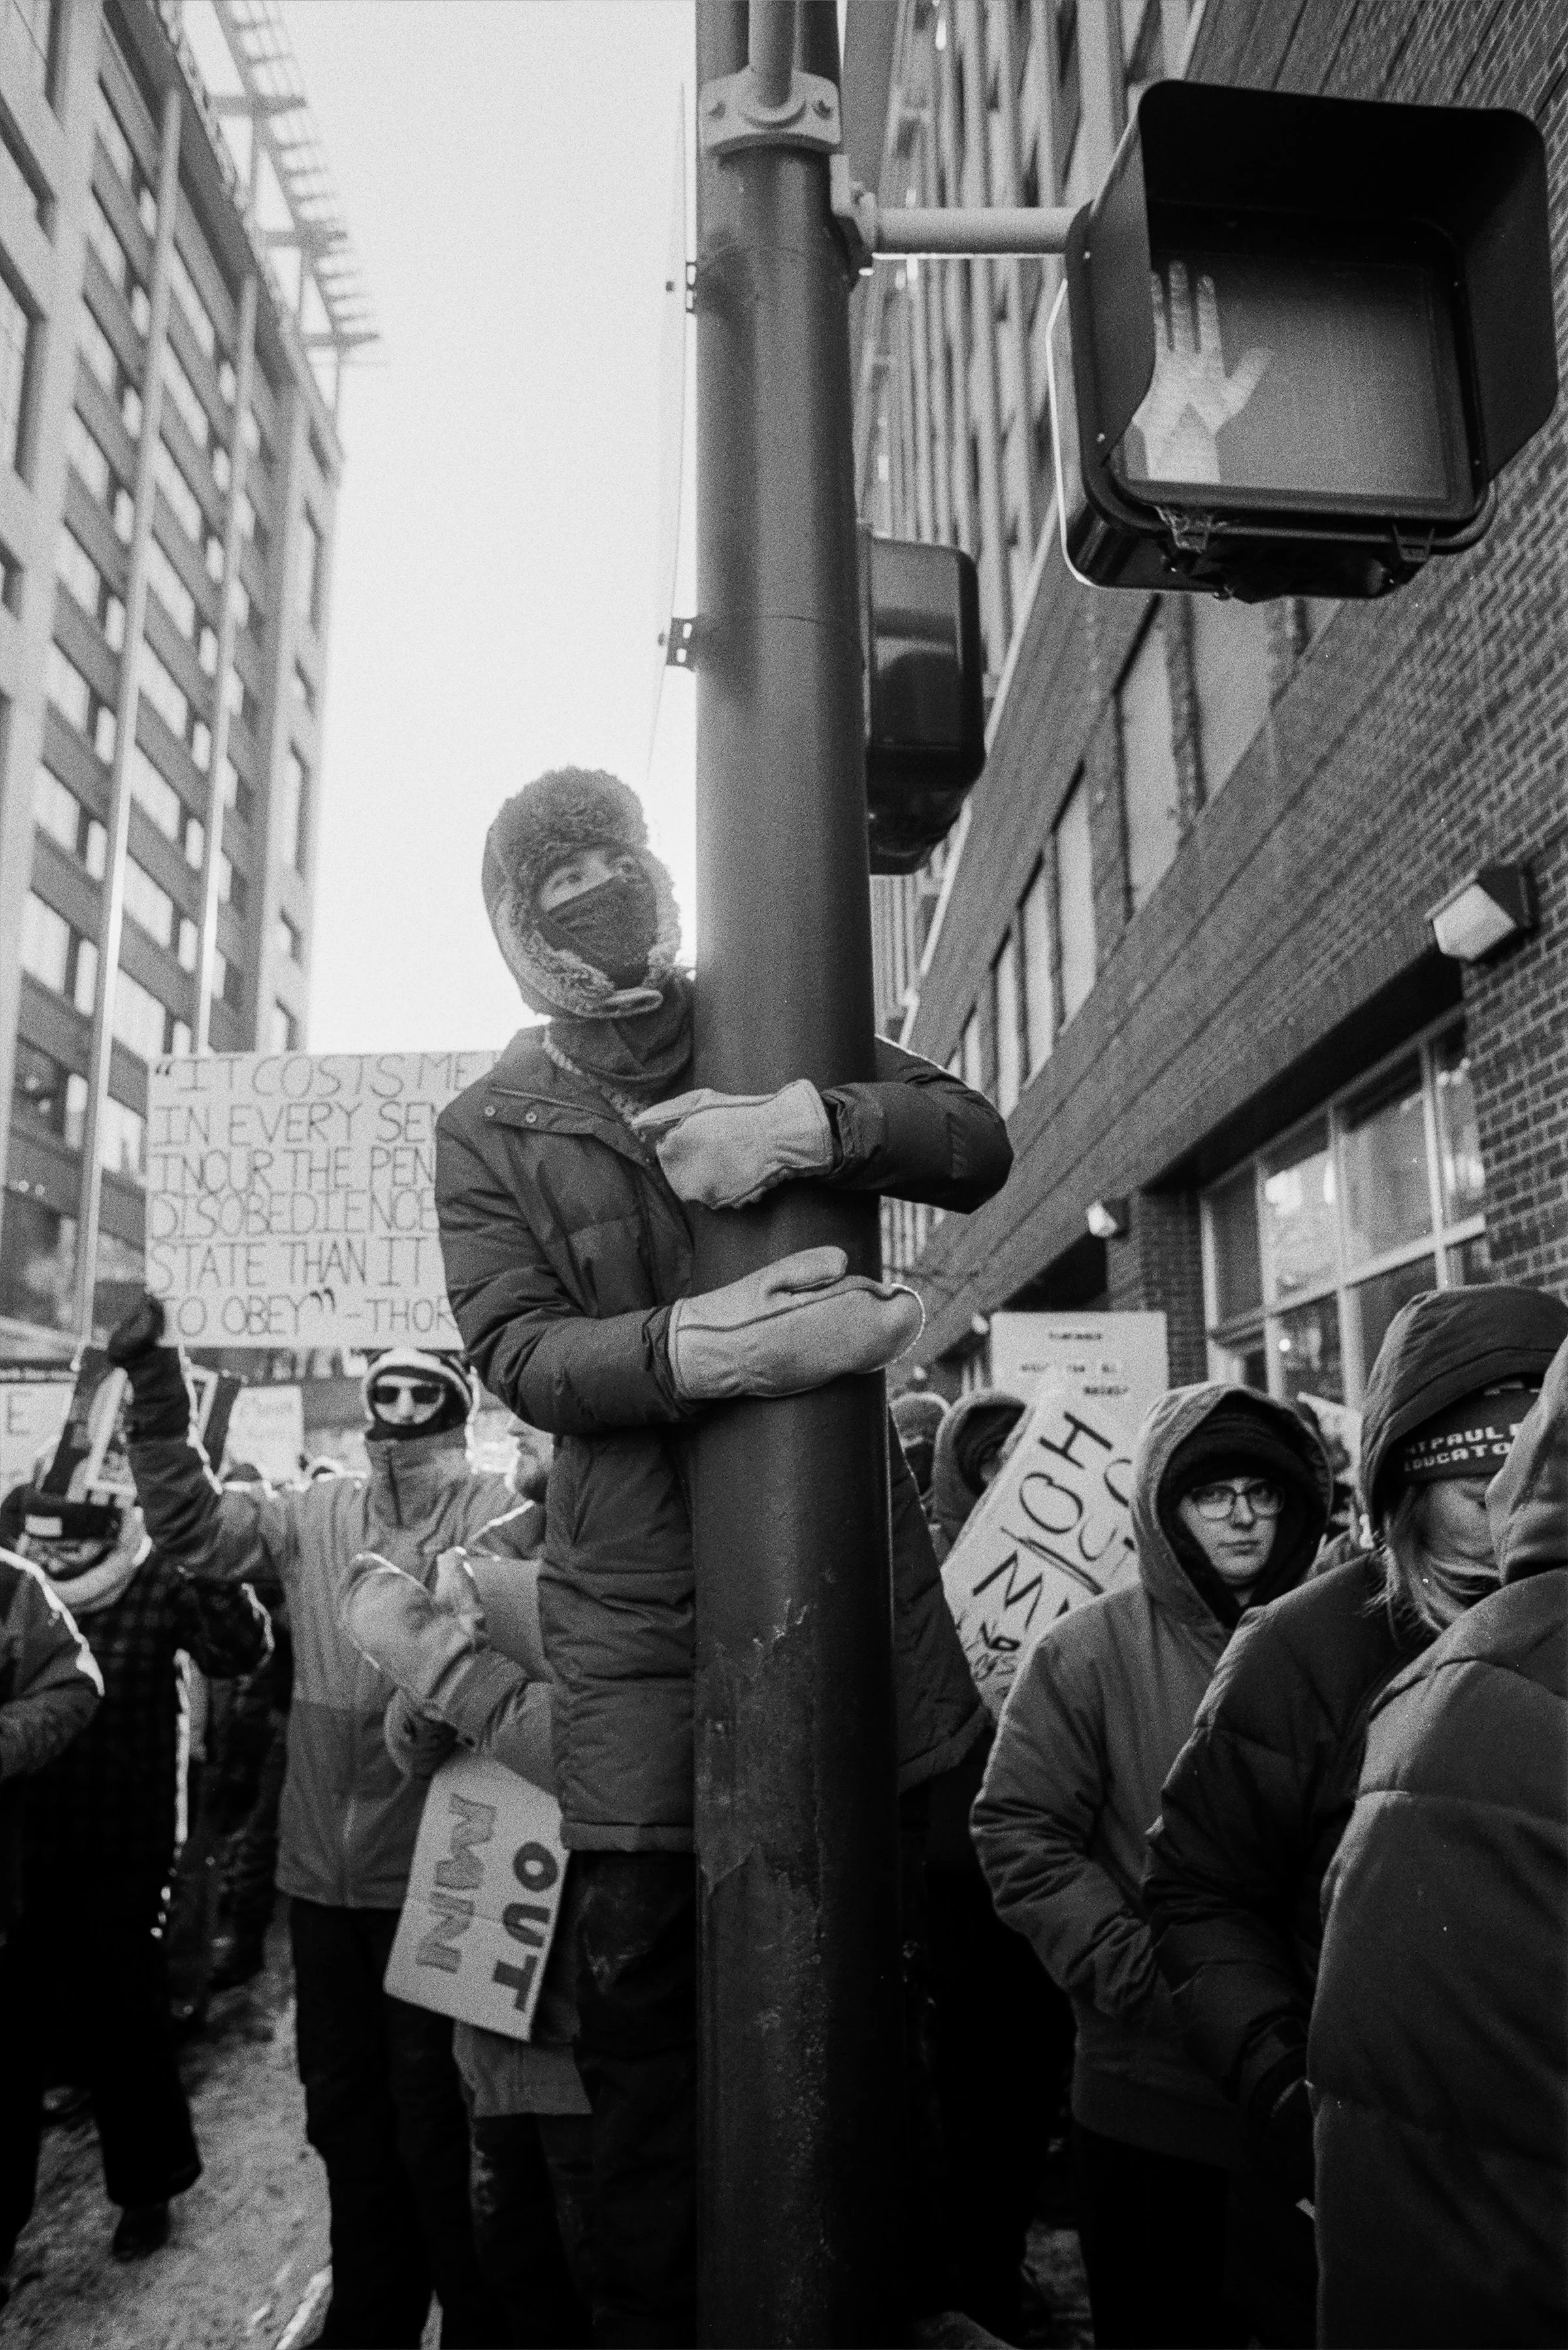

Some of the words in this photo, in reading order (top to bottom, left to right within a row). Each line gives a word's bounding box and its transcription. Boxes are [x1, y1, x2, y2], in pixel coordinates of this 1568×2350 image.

[252, 1054, 404, 1098] COSTS
[417, 1052, 478, 1091] ME
[151, 1105, 209, 1147] IN
[229, 1102, 362, 1147] EVERY
[283, 1147, 351, 1188] THE
[150, 1240, 266, 1294] STATE
[280, 1239, 367, 1286] THAN
[378, 1236, 429, 1287] IT
[1430, 1425, 1505, 1450] PAUL
[491, 1841, 558, 2013] OUT
